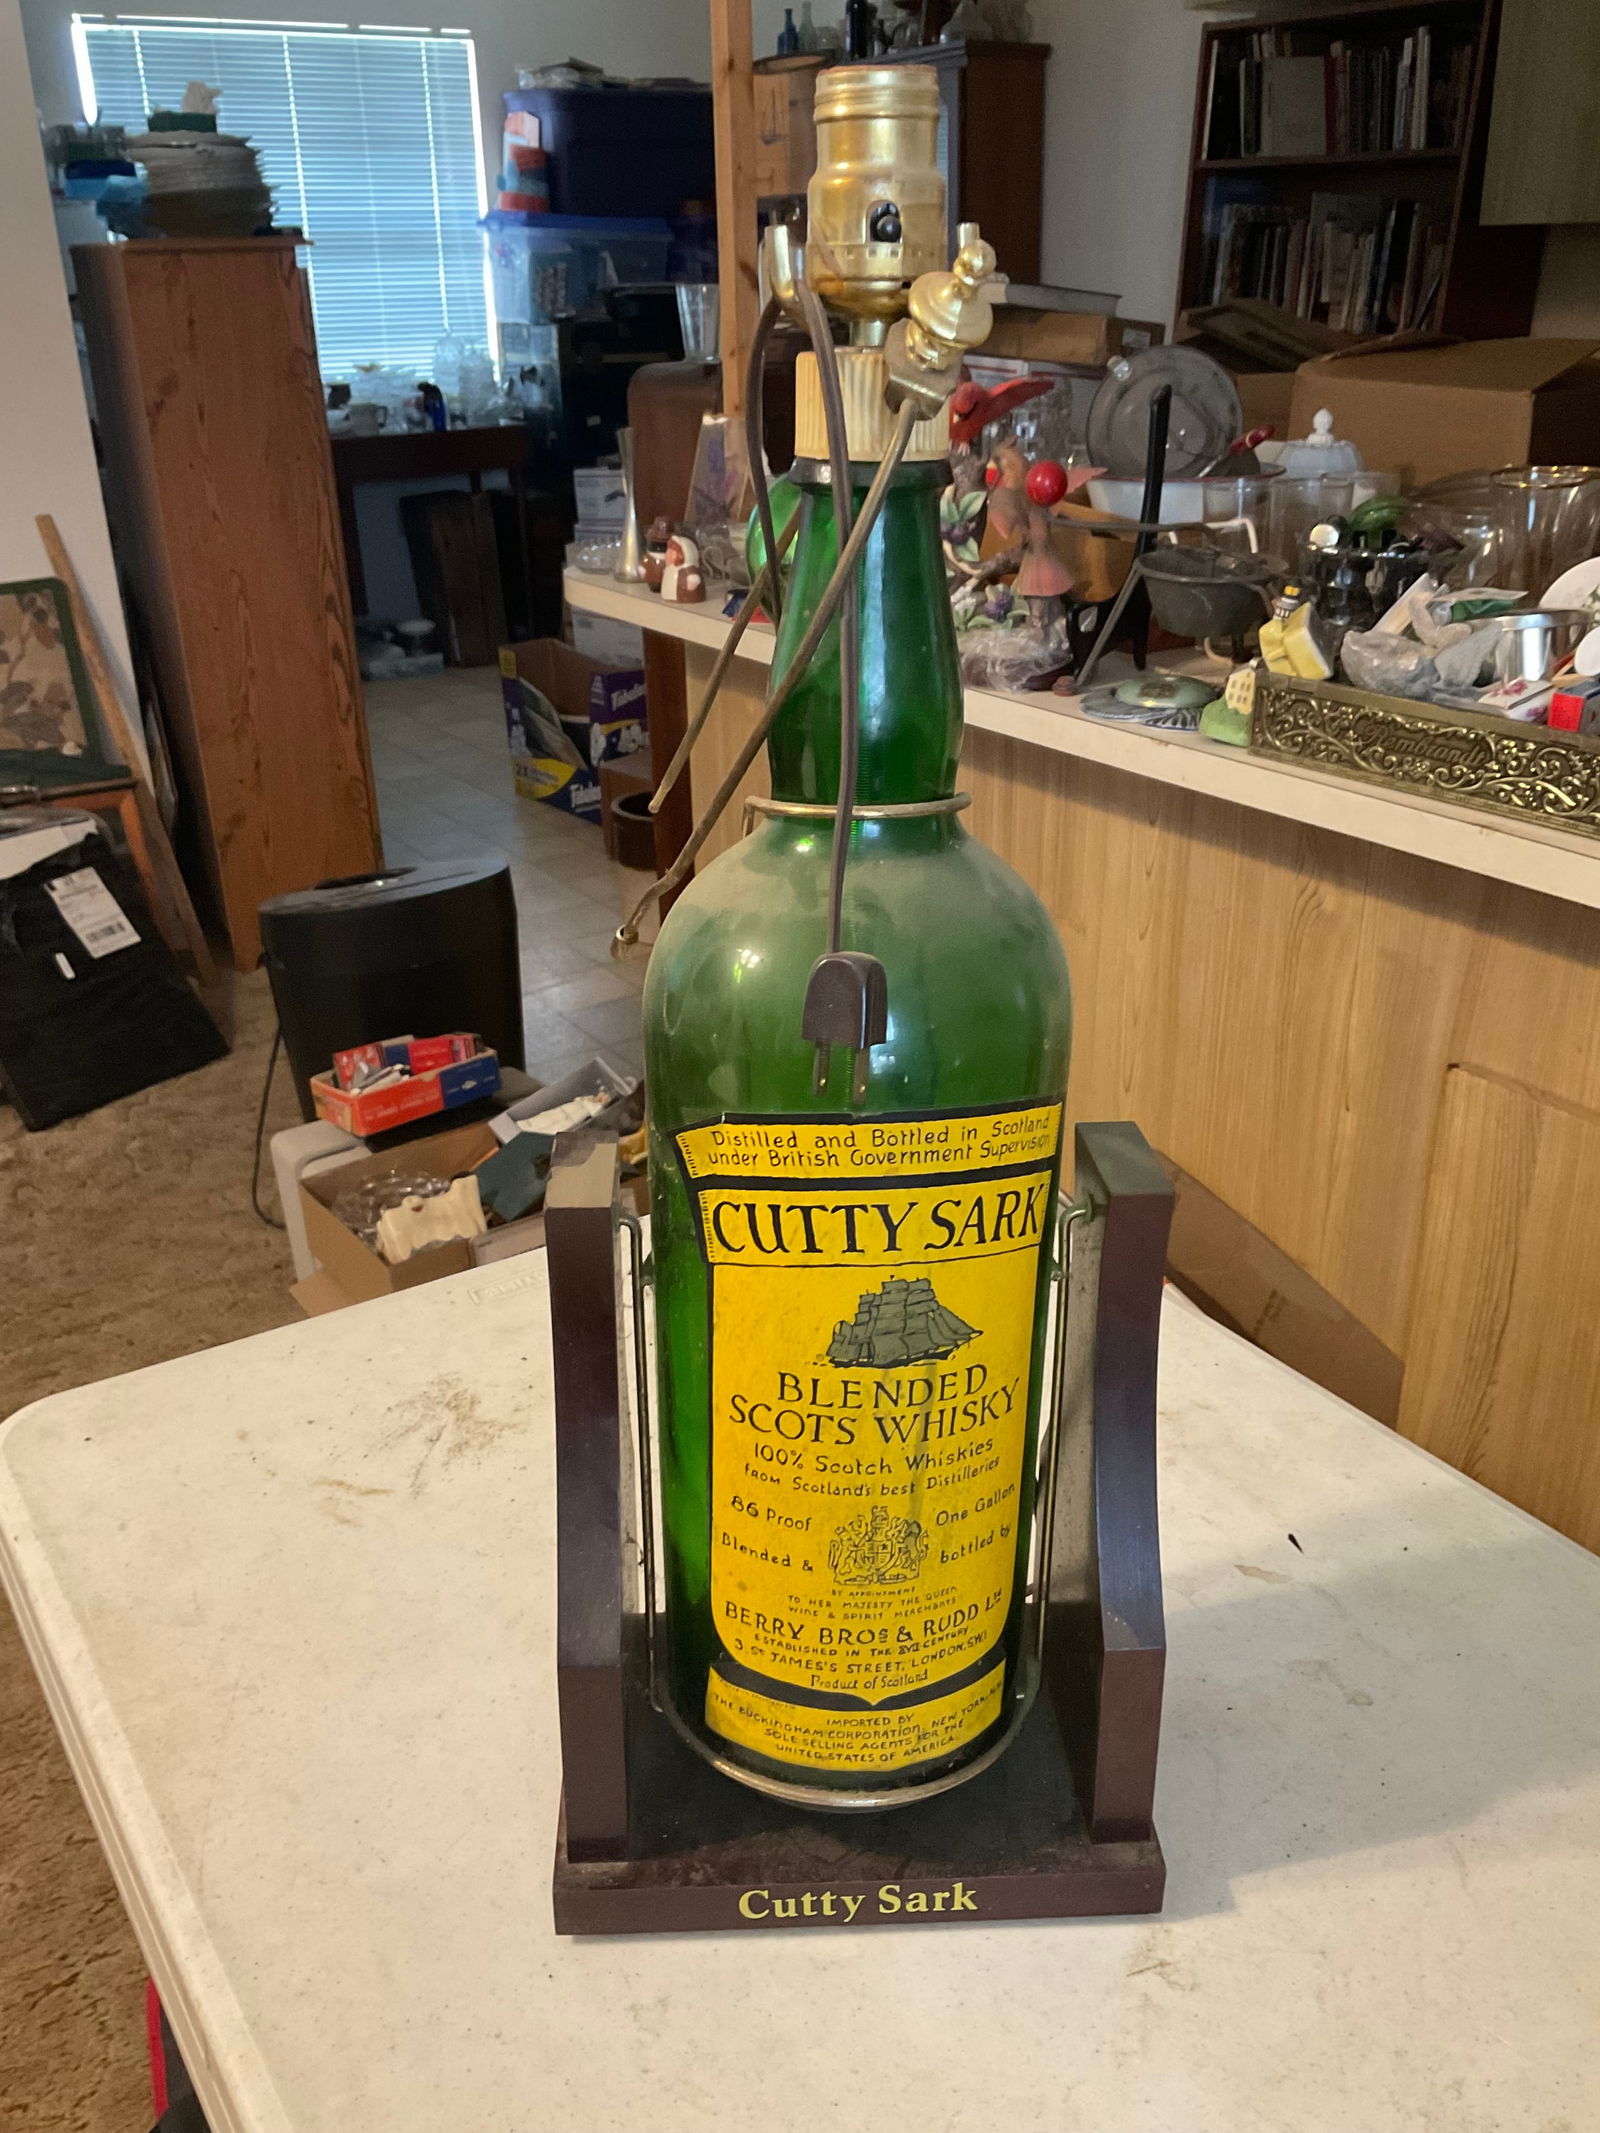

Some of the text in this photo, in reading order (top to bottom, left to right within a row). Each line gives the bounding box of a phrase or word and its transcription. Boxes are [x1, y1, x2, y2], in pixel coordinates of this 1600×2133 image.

[1362, 724, 1488, 767] Rembrandt
[708, 1150, 759, 1166] under
[769, 1147, 839, 1167] British
[850, 1142, 973, 1167] Government
[980, 1132, 1052, 1161] Supervision
[711, 1115, 1050, 1148] Distilled and Bottled in Scotland
[712, 1200, 919, 1254] CUTTY
[924, 1183, 1045, 1252] SARK
[777, 1364, 988, 1410] BLENDED
[729, 1376, 1020, 1446] SCOTS WHISKY
[755, 1437, 994, 1476] 100% Scotch Whiskies
[792, 1476, 872, 1497] Scotland's
[880, 1481, 916, 1496] best
[926, 1456, 1001, 1489] Distilleries
[730, 1495, 814, 1533] 86 Proof
[935, 1484, 1016, 1527] One Gallon
[722, 1532, 814, 1573] Blended &
[939, 1521, 1011, 1564] bottled by
[788, 1586, 957, 1609] TO HER MAJESTY THE QUEEN
[828, 1611, 836, 1619] &
[843, 1611, 883, 1620] SPIRIT
[725, 1600, 805, 1641] BERRY
[896, 1626, 913, 1643] &
[924, 1603, 979, 1637] RUDD
[734, 1638, 744, 1650] 3
[770, 1652, 837, 1673] JAMES'S
[755, 1633, 837, 1657] ESTABLISHED
[870, 1647, 891, 1657] THE
[923, 1626, 969, 1648] CENTURY
[811, 1669, 928, 1689] Product of Scotland
[714, 1693, 733, 1709] THE
[739, 1705, 823, 1737] BUCKINGHAM
[931, 1713, 957, 1728] NEW
[764, 1728, 799, 1743] SOLE
[802, 1736, 853, 1749] SELLING
[860, 1738, 912, 1750] AGENTS
[945, 1719, 964, 1733] THE
[827, 1713, 914, 1727] IMPORTED BY
[879, 1753, 896, 1762] OF
[738, 1882, 978, 1923] Cutty Sark
